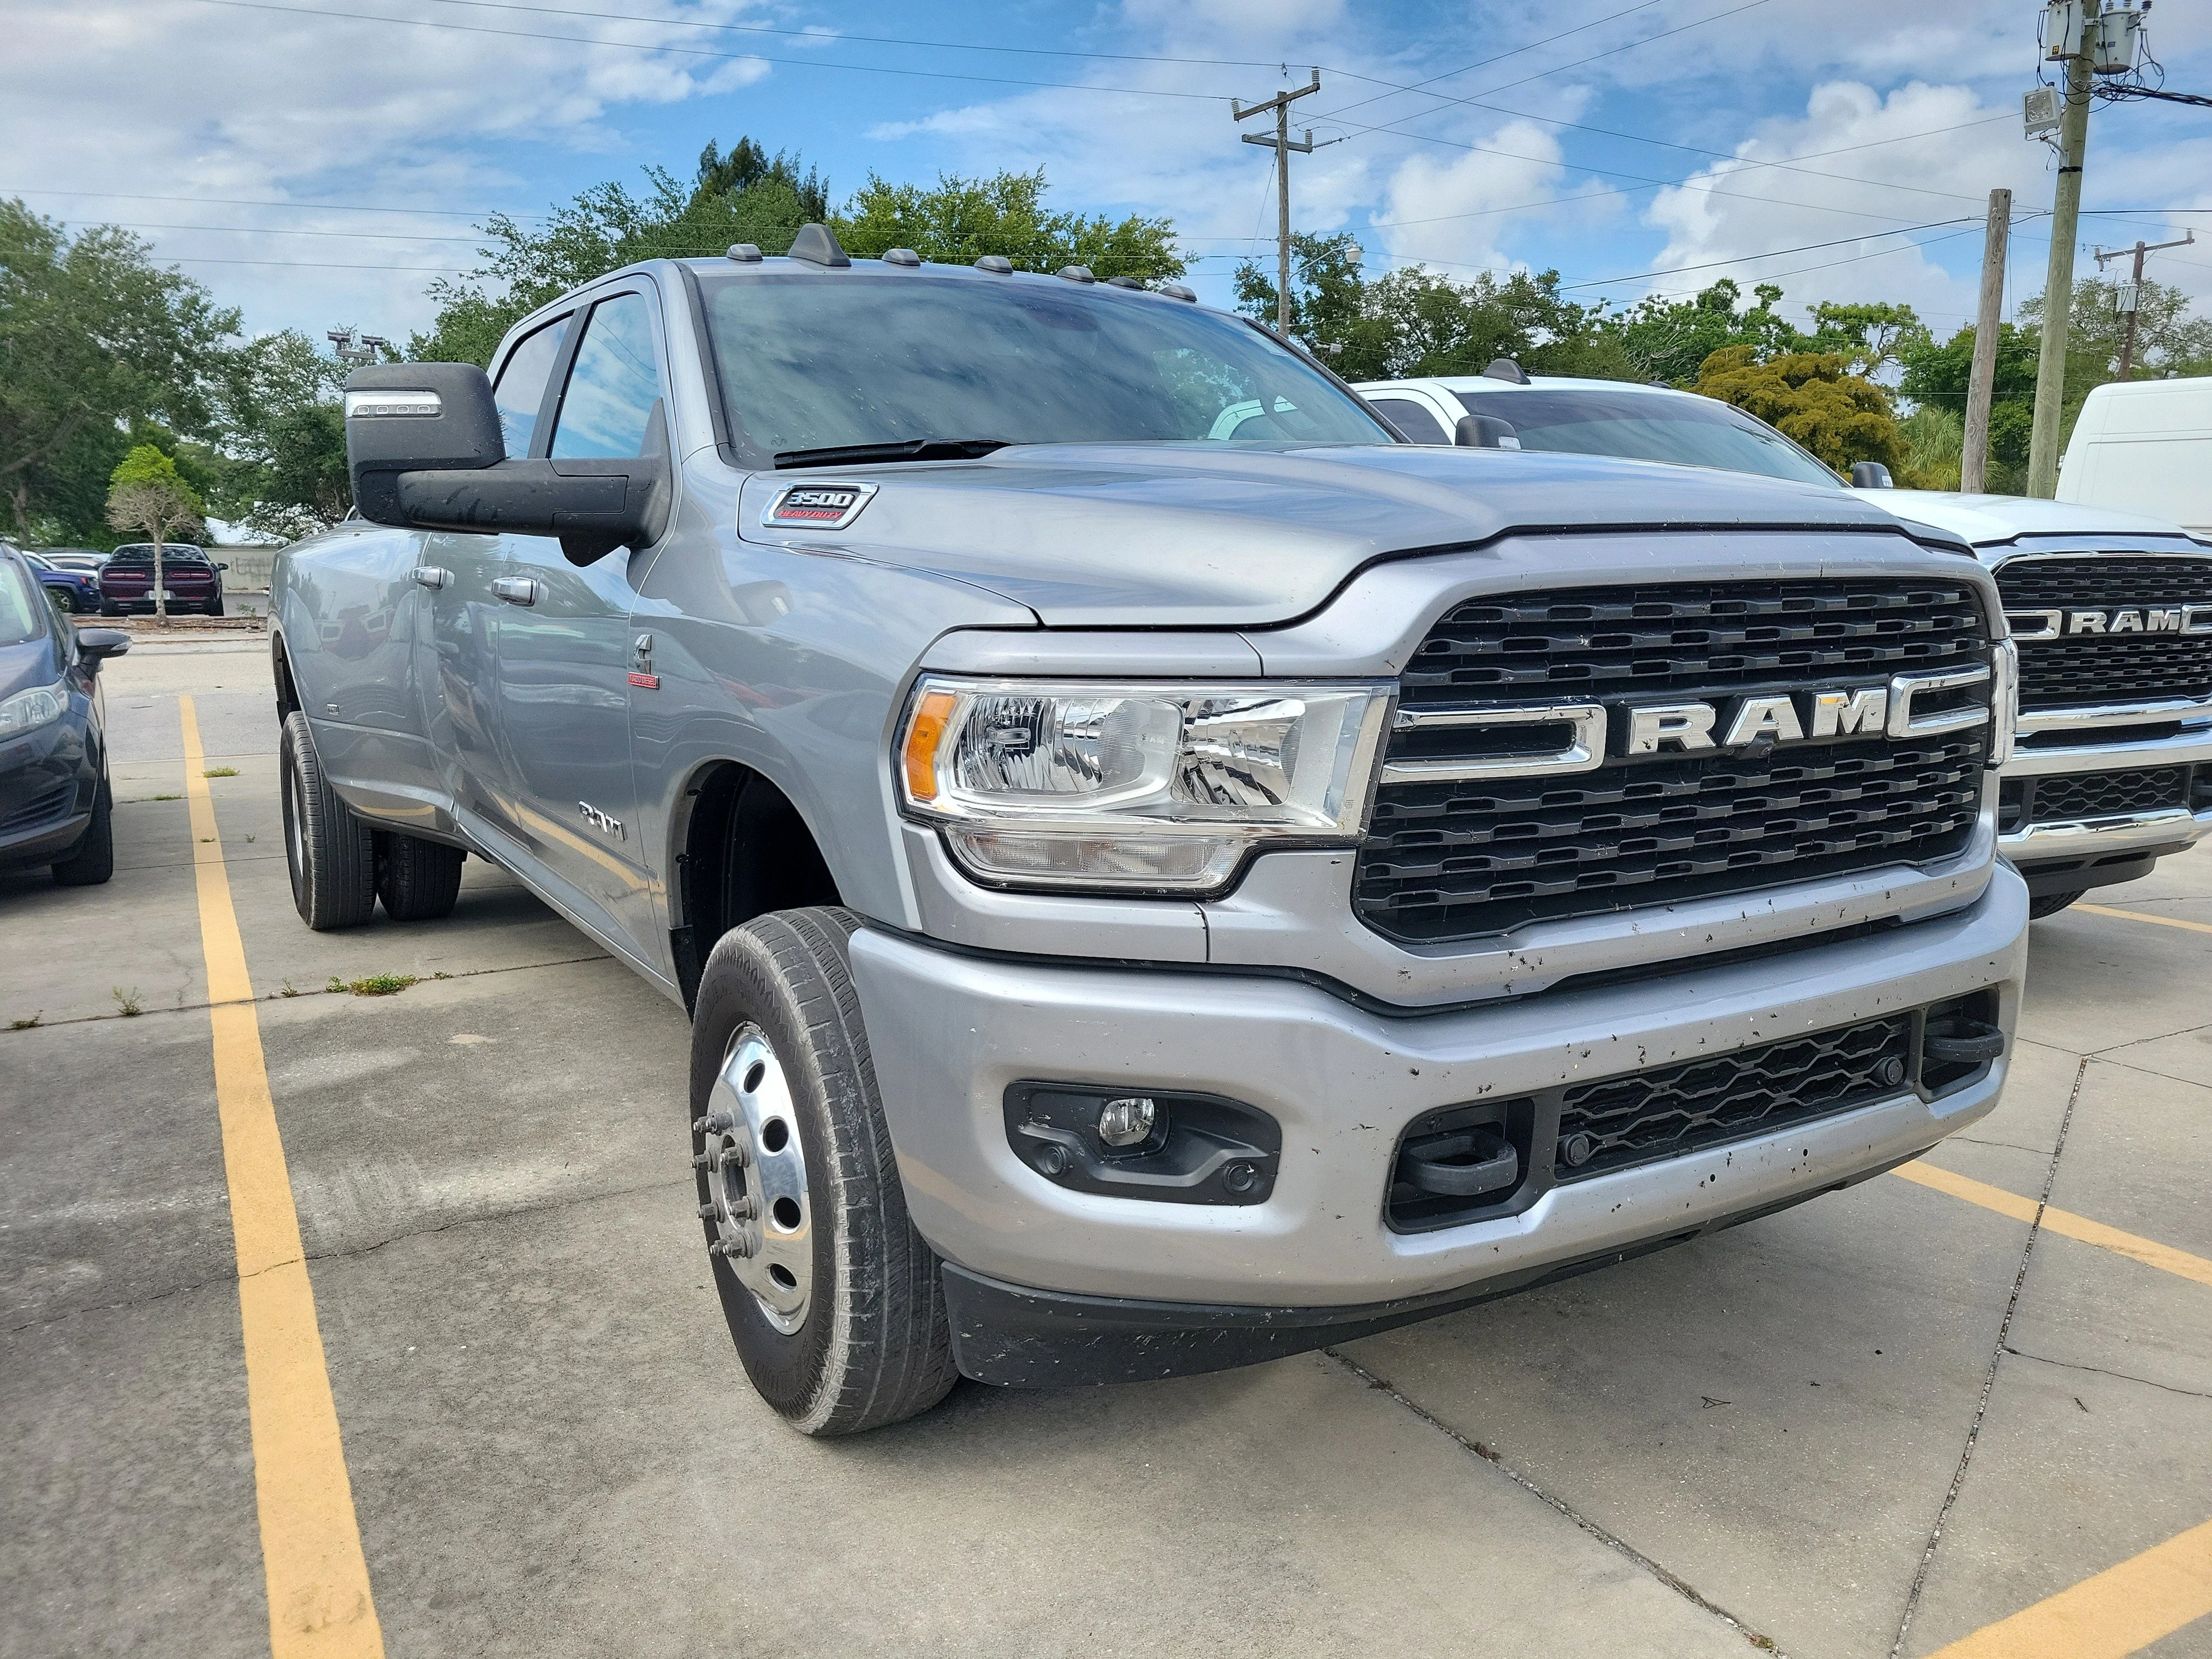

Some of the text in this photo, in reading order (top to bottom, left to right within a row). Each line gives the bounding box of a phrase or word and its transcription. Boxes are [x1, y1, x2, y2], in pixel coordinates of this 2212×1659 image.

[787, 492, 854, 507] 3500
[811, 511, 843, 520] DUTY
[2069, 609, 2181, 634] RAM
[1628, 686, 1887, 755] RAM
[578, 800, 626, 842] RAM
